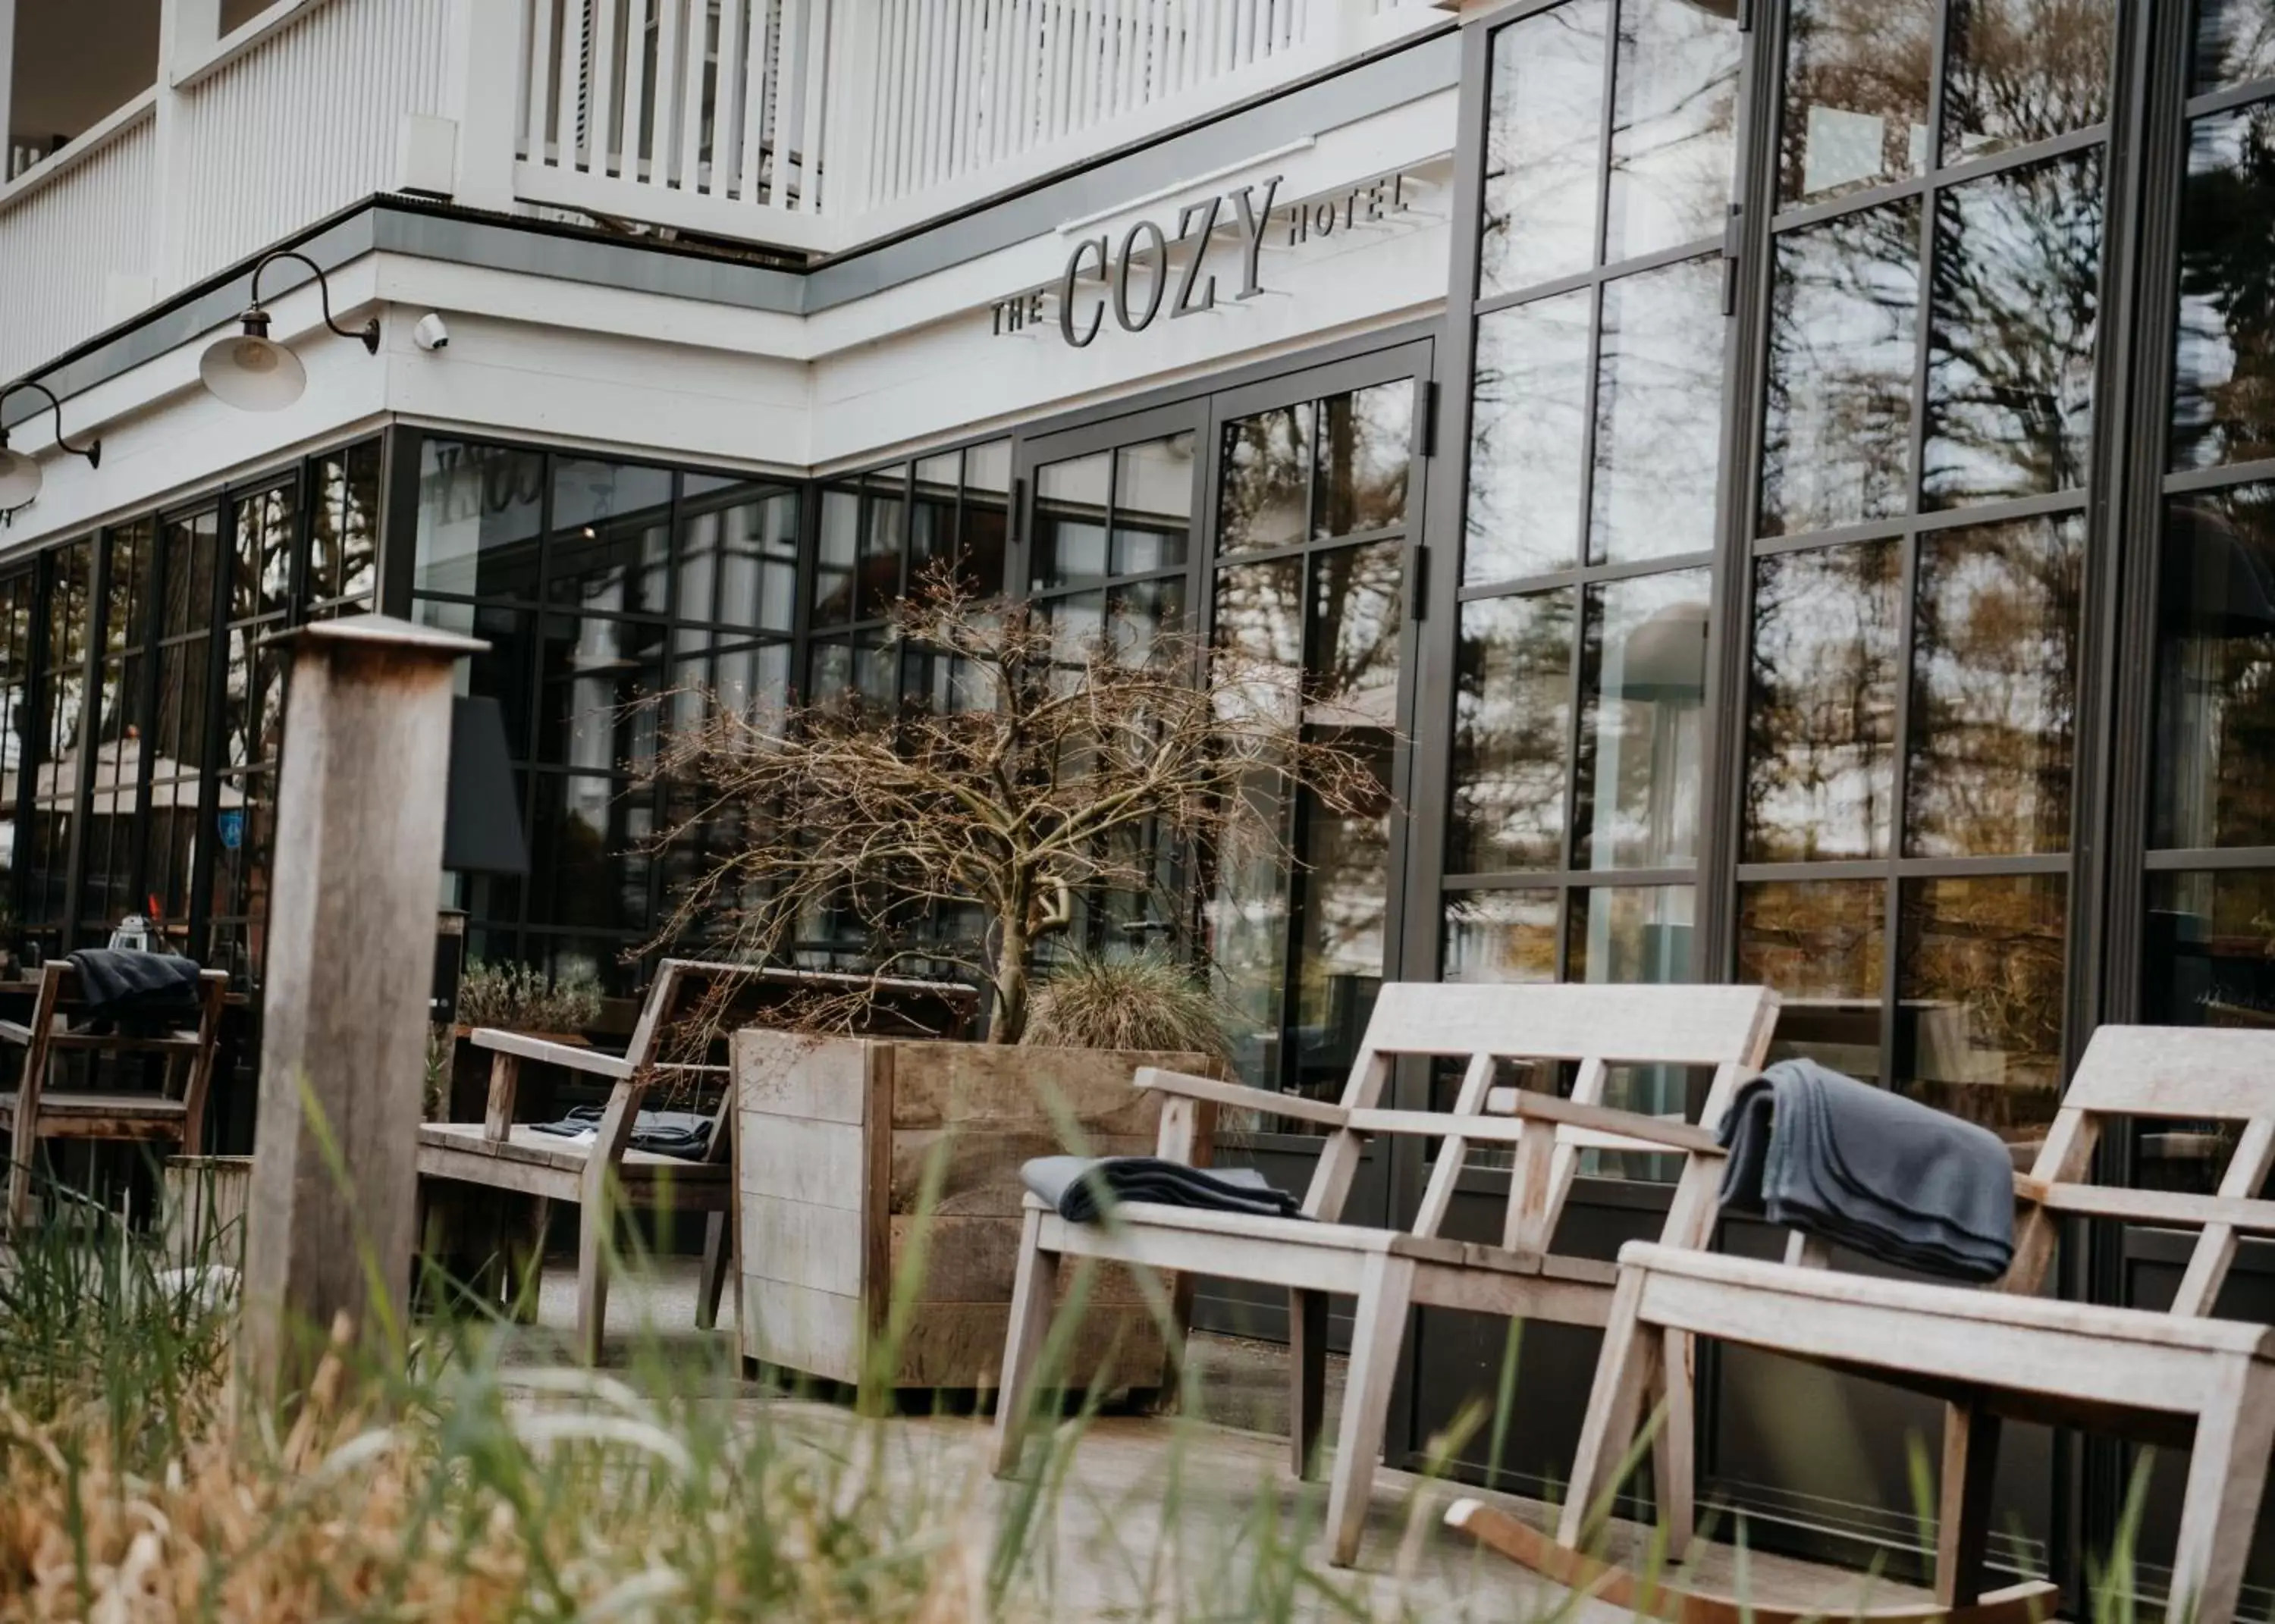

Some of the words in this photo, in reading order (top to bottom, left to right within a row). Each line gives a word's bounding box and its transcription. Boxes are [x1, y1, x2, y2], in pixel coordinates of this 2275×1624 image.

[990, 288, 1044, 336] THE
[1059, 174, 1284, 348] COZY
[1288, 173, 1408, 246] HOTEL
